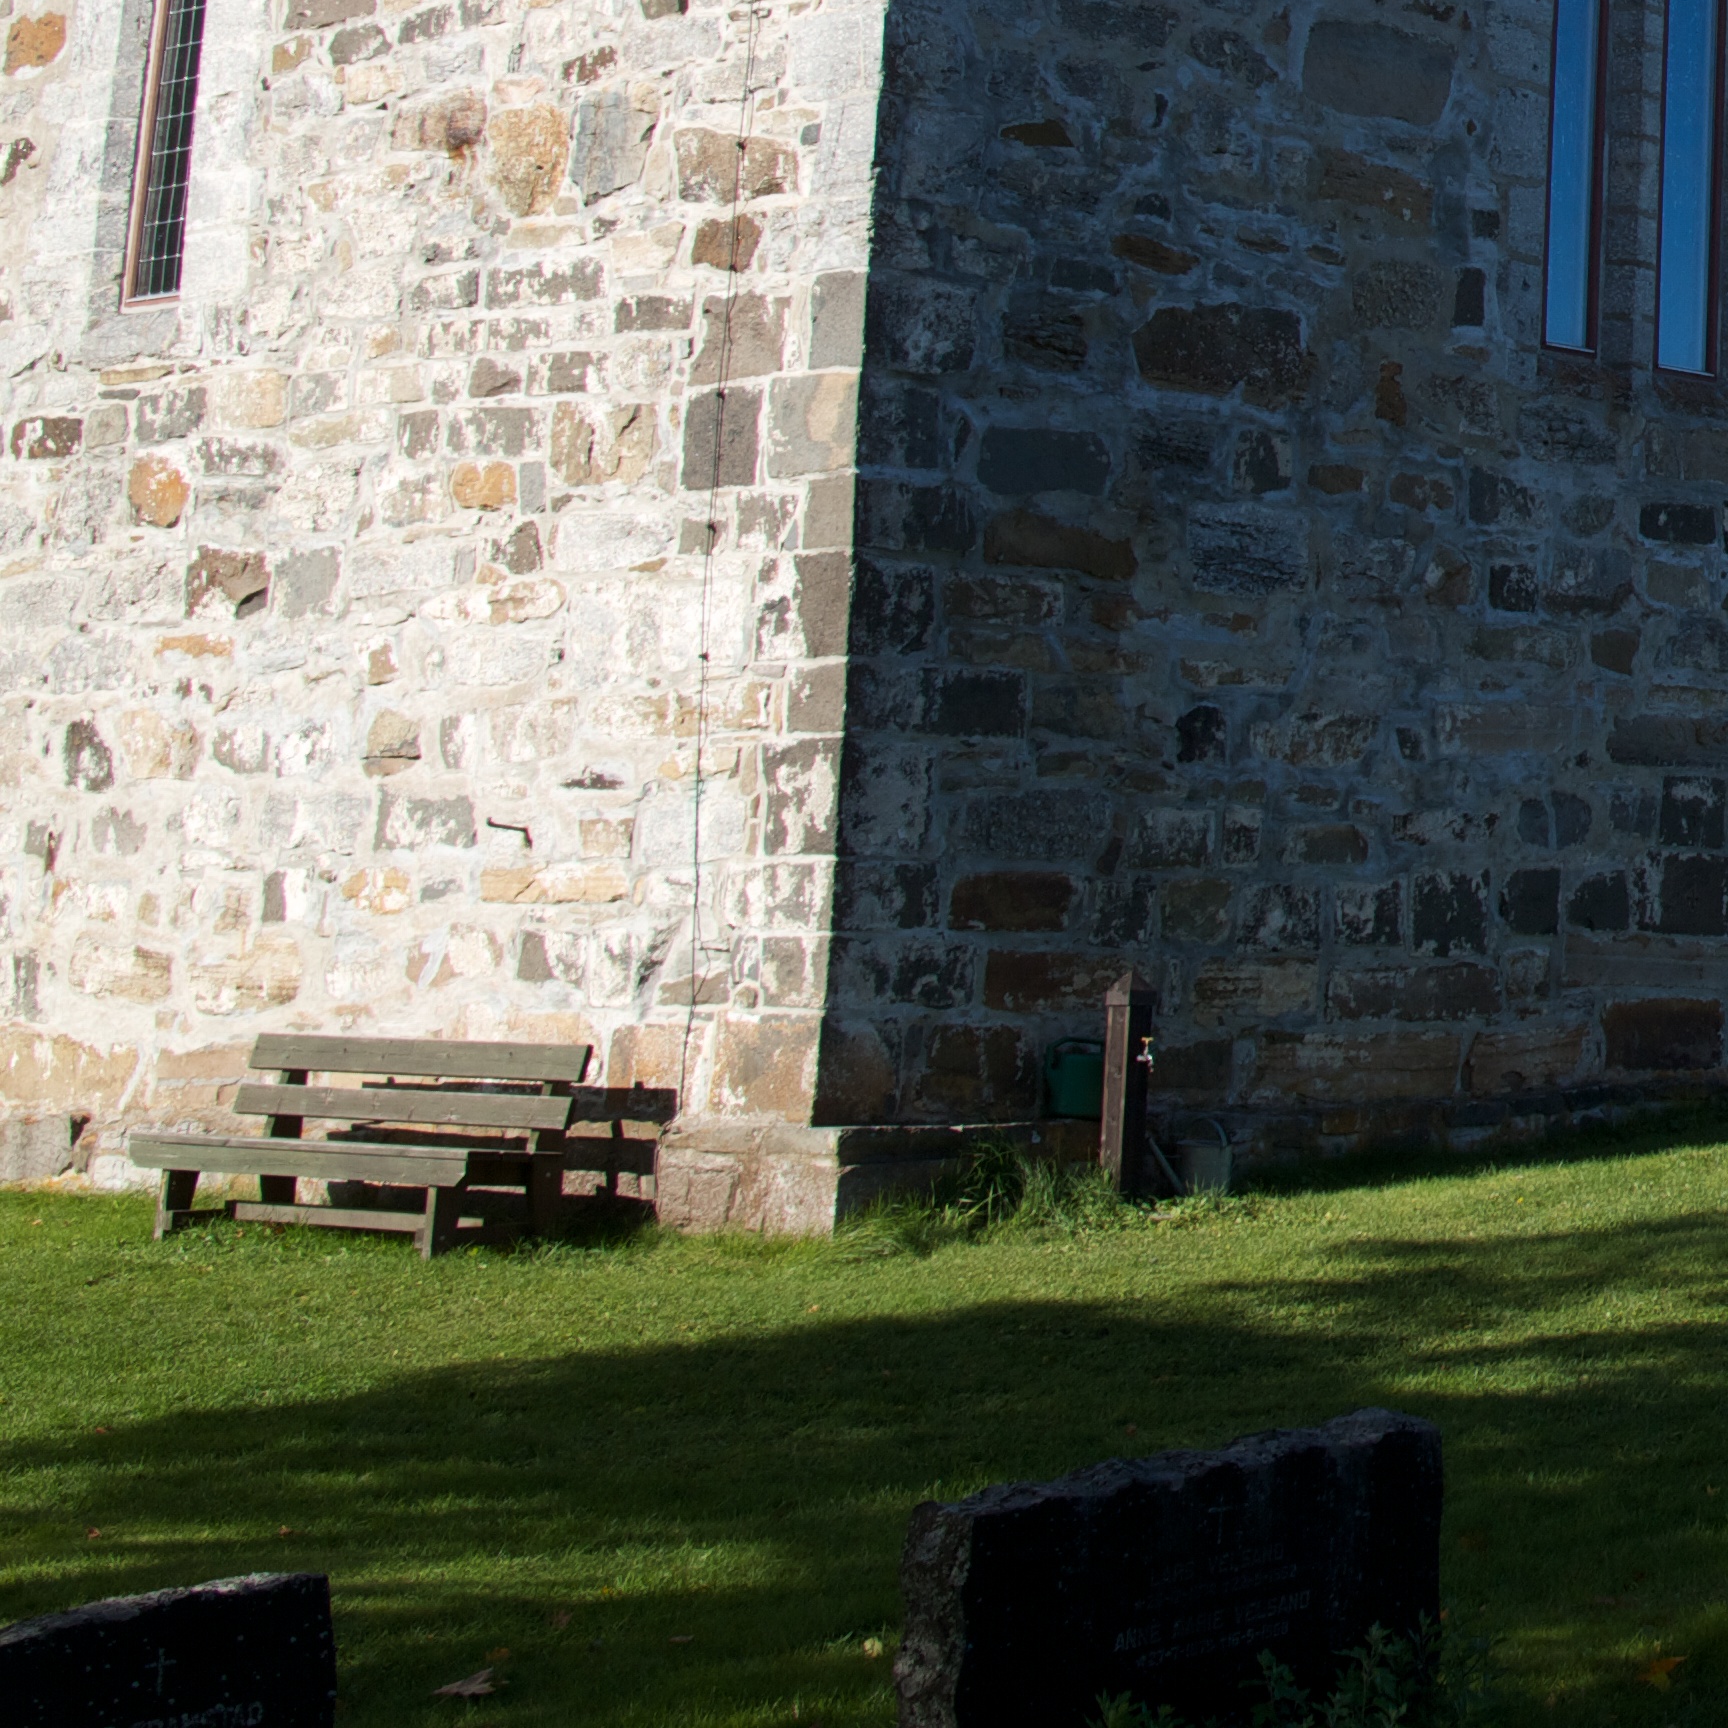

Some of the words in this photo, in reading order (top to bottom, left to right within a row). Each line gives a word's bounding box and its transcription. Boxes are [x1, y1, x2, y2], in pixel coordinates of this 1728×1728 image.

[1207, 1542, 1285, 1575] VELSAND
[1112, 1622, 1163, 1653] ANNE
[1171, 1608, 1225, 1640] MARIE
[1234, 1589, 1312, 1625] VELSAND
